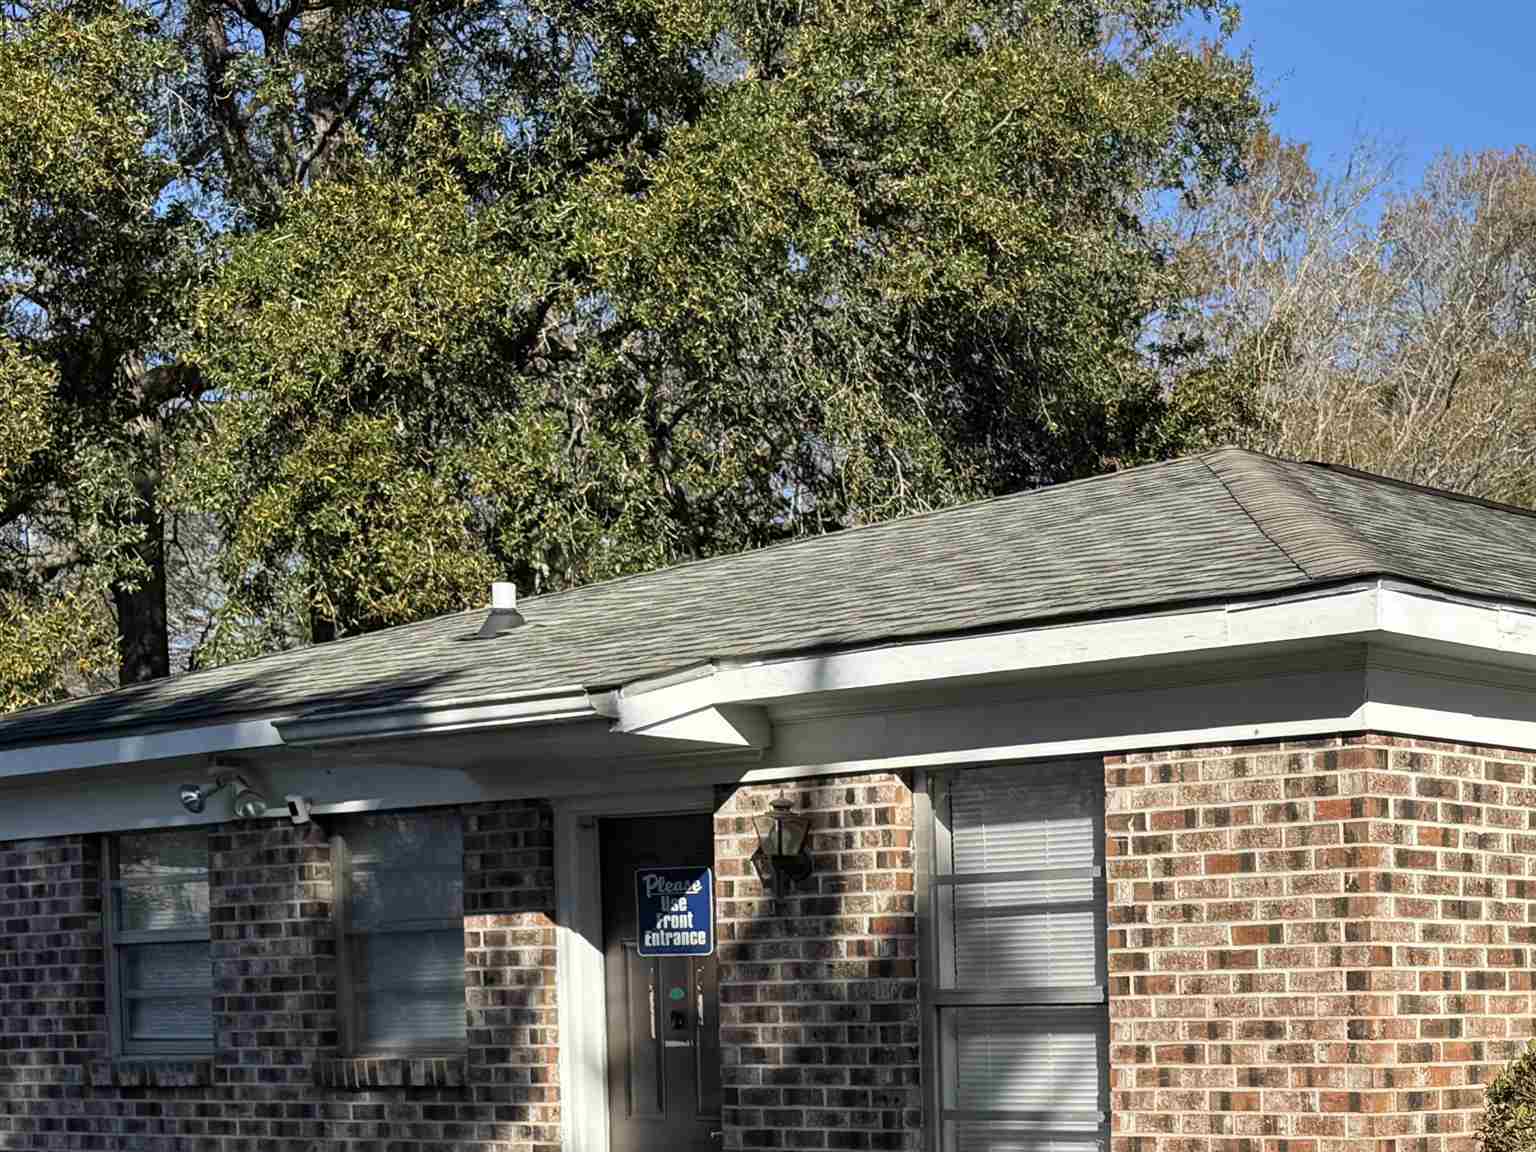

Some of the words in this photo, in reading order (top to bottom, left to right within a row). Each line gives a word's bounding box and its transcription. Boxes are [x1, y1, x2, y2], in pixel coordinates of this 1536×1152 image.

[643, 874, 703, 898] Please
[661, 896, 688, 912] Use
[656, 911, 694, 929] Front
[644, 930, 706, 947] Entrance
